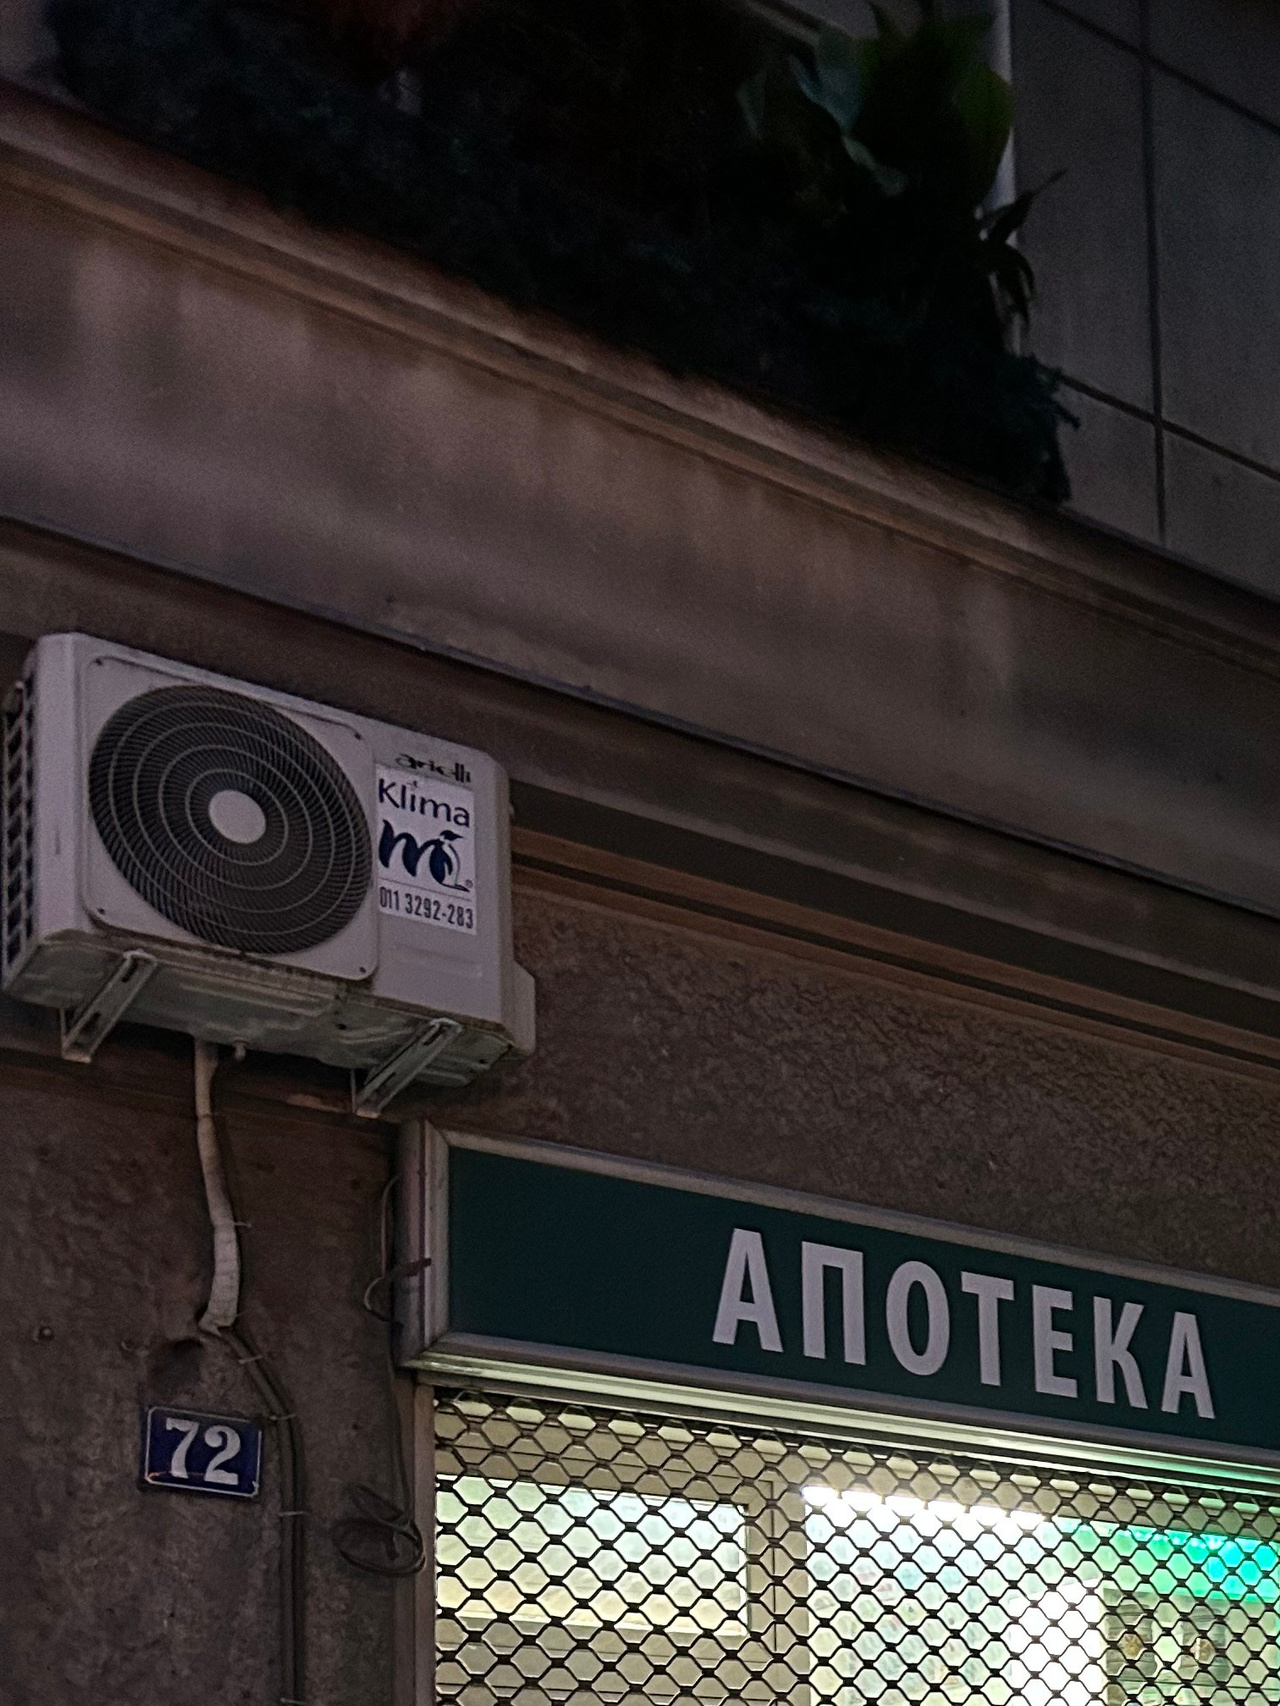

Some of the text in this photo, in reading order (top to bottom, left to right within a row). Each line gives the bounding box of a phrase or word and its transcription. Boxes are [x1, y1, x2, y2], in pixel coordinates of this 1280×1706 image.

[378, 778, 471, 828] Klima
[379, 886, 474, 929] 011 3292-283
[711, 1227, 1217, 1420] АПОТЕКА
[165, 1417, 242, 1486] 72
